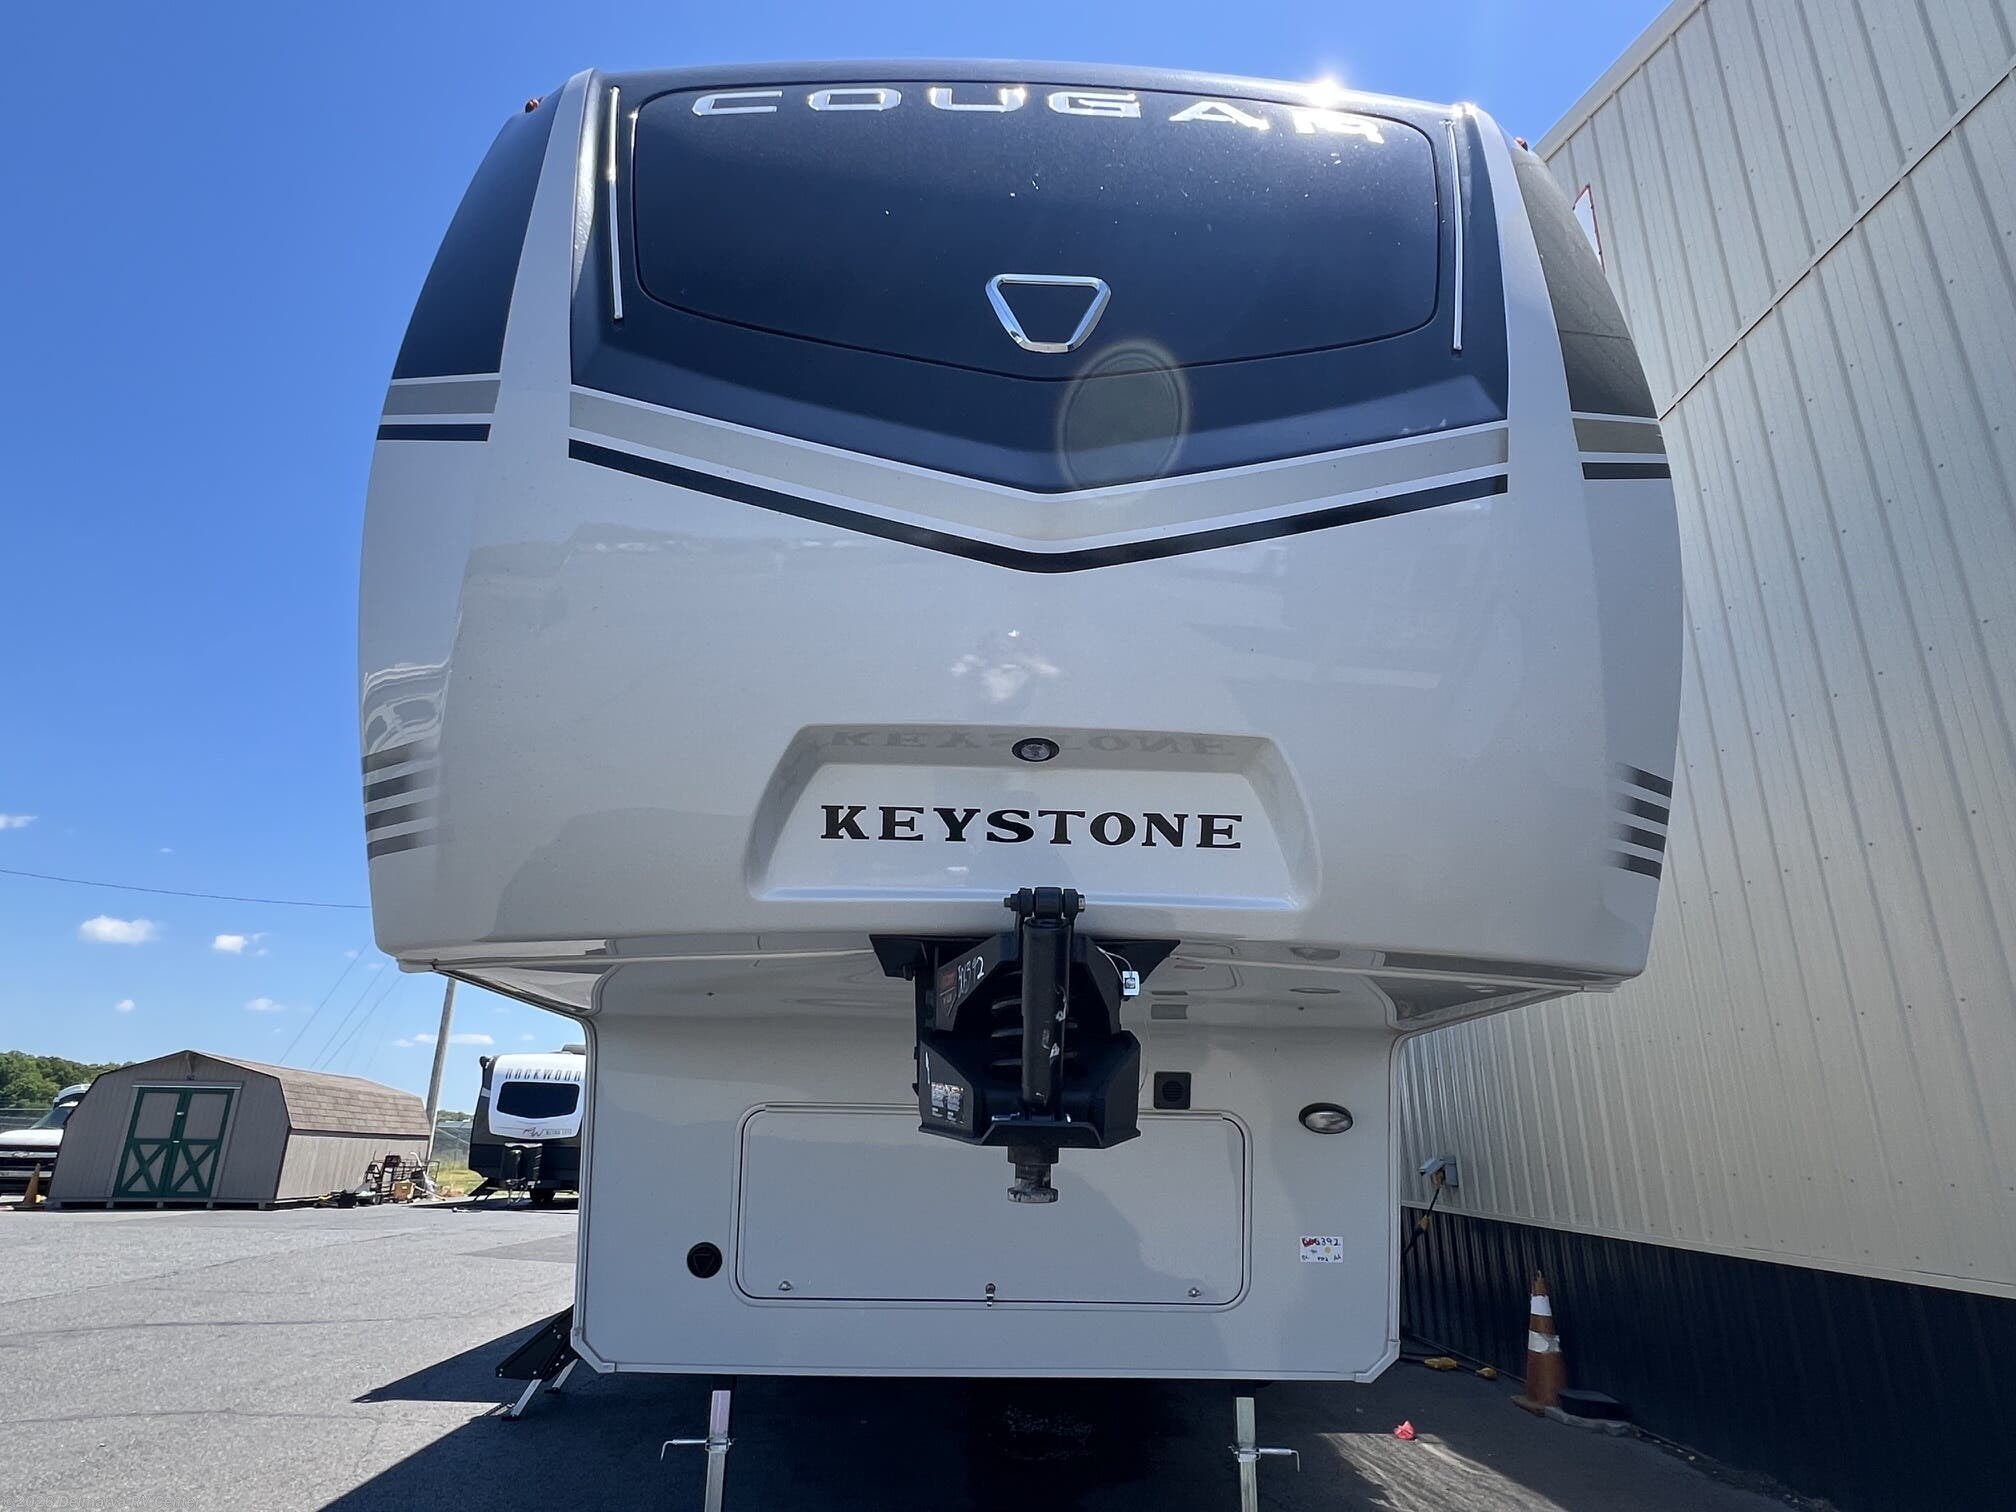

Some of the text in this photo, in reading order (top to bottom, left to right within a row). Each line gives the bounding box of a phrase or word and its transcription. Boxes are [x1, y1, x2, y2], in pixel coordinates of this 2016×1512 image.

[691, 86, 1385, 144] COUGAR
[820, 804, 1243, 849] KEYSTONE
[505, 1067, 582, 1082] ROCKWOOD
